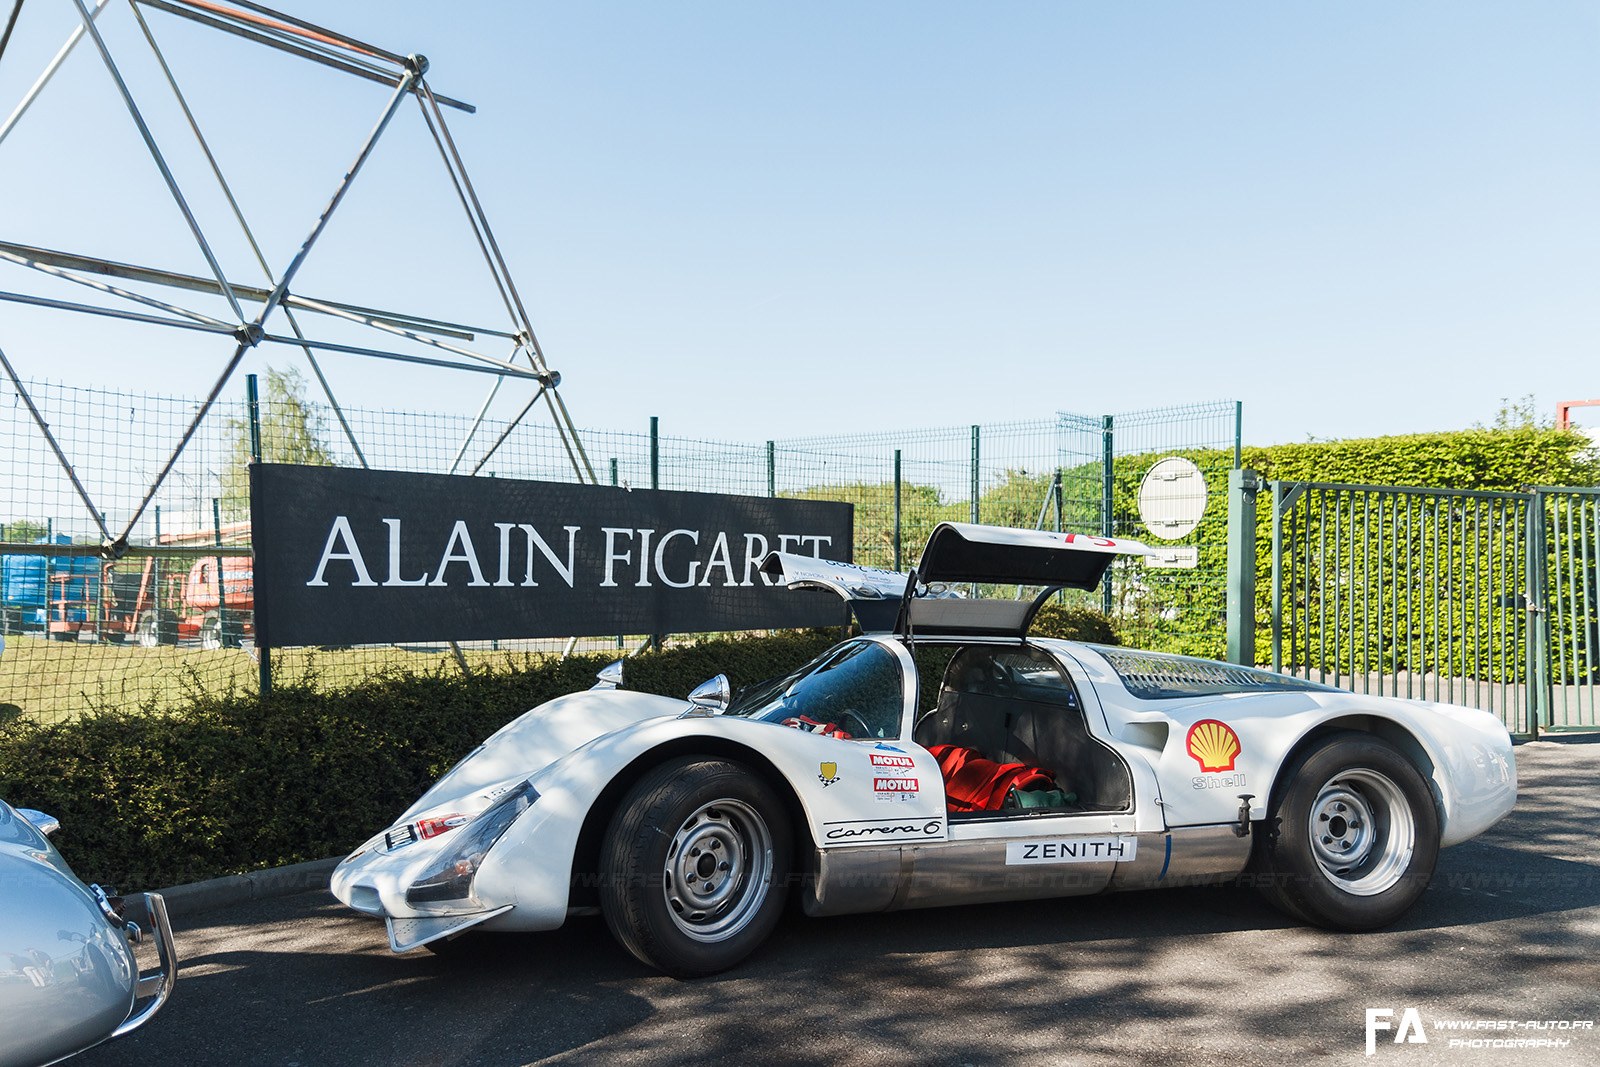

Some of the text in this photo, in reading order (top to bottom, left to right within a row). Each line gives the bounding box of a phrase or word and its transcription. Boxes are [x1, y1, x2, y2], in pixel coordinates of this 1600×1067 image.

[306, 516, 581, 588] ALAIN
[873, 756, 912, 766] MOTUL
[876, 780, 917, 790] MOTUL
[1191, 773, 1246, 790] Shell
[923, 821, 941, 834] 6
[1023, 842, 1124, 859] ZENITH
